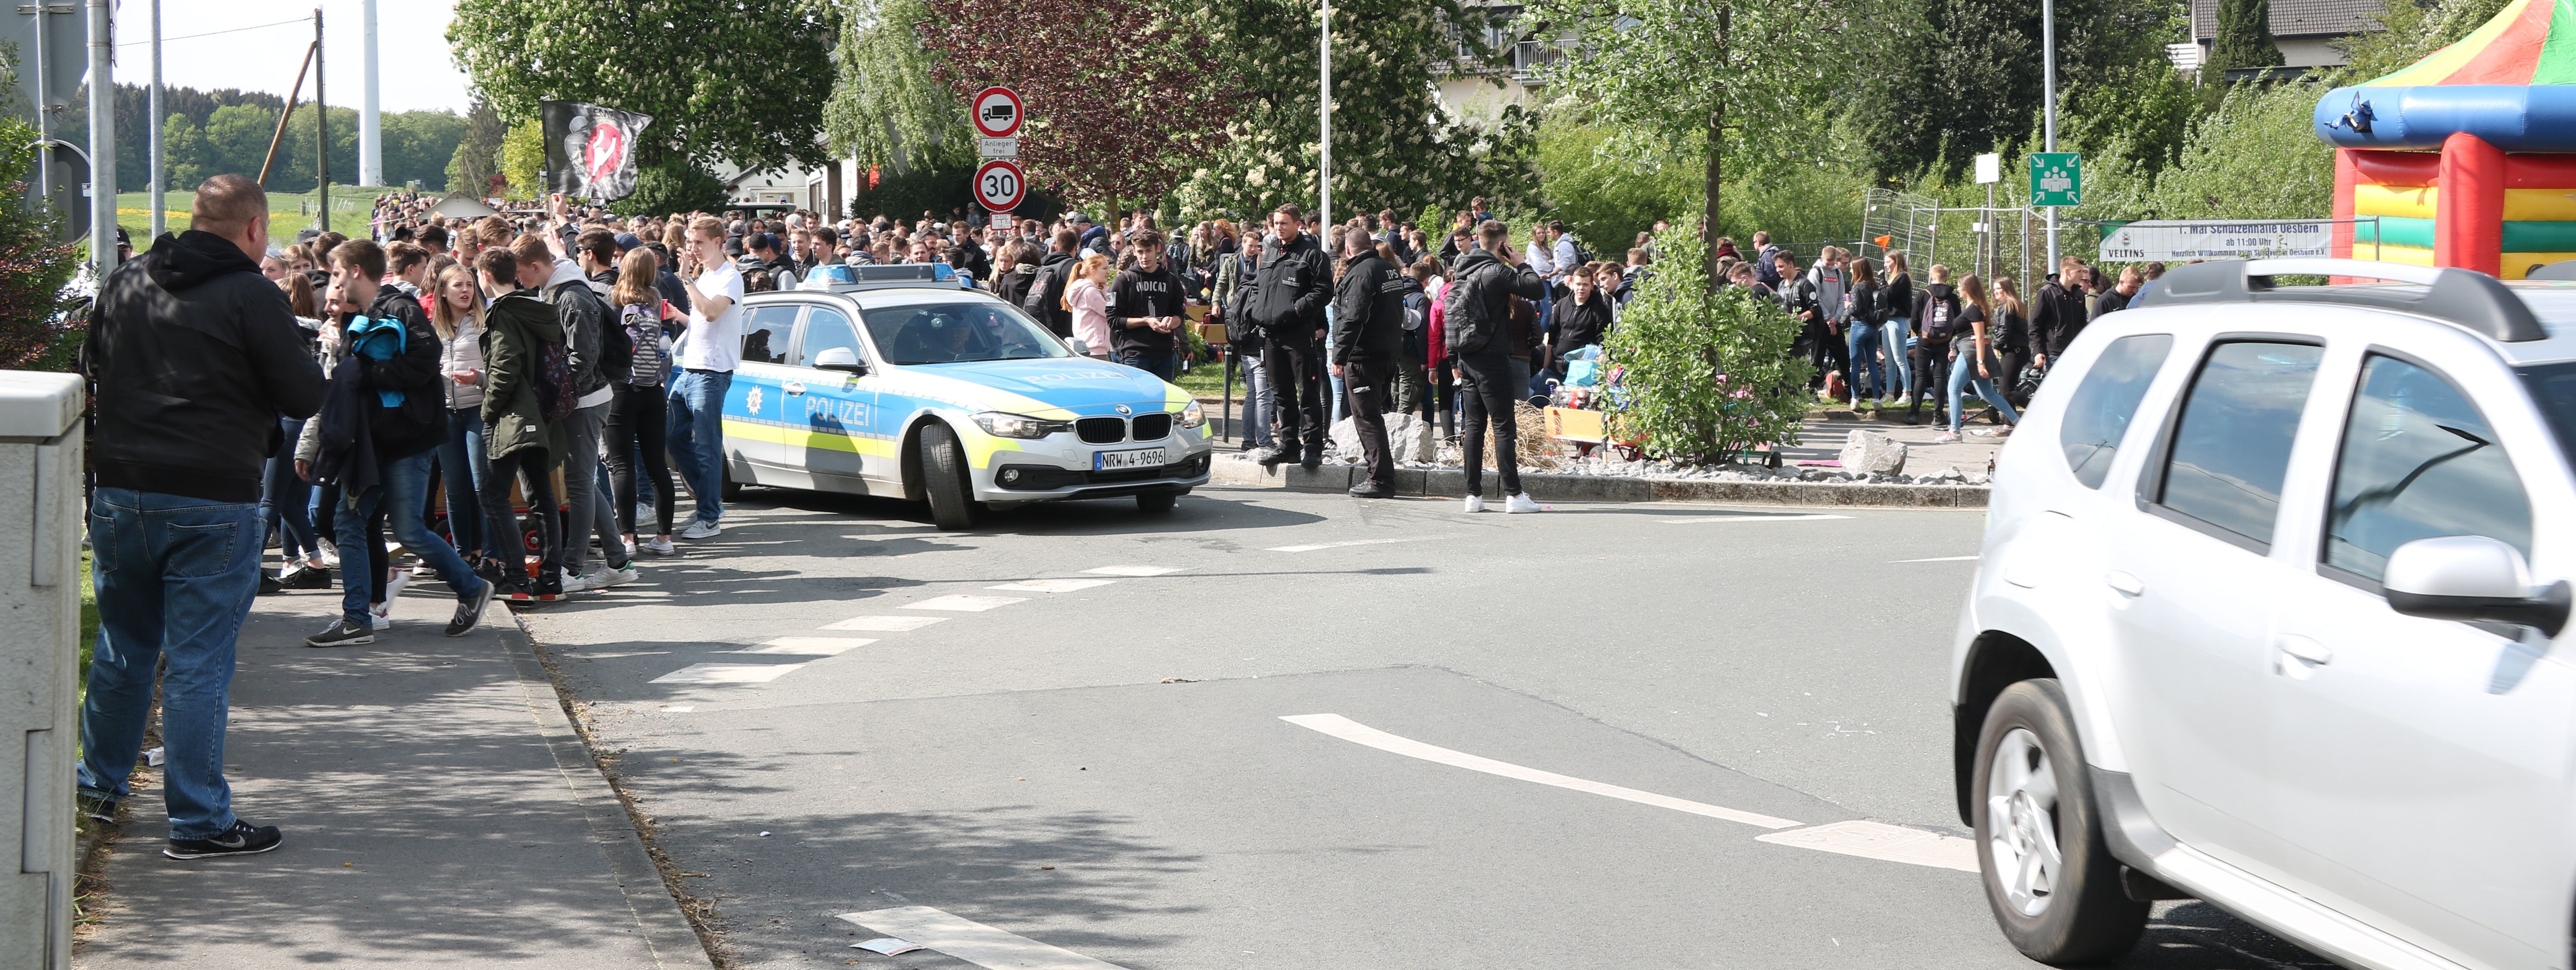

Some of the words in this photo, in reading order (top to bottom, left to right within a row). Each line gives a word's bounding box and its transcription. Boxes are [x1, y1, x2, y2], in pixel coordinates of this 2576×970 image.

[985, 174, 1014, 197] 30
[2280, 223, 2318, 233] Oesbern
[2259, 238, 2271, 246] Uhr
[2108, 249, 2144, 258] VELTINS
[1385, 269, 1398, 279] IPS
[1022, 372, 1130, 383] POLIZEI
[805, 396, 870, 426] POLIZEI
[1102, 453, 1122, 467] NRW
[1129, 450, 1163, 466] 4-9696
